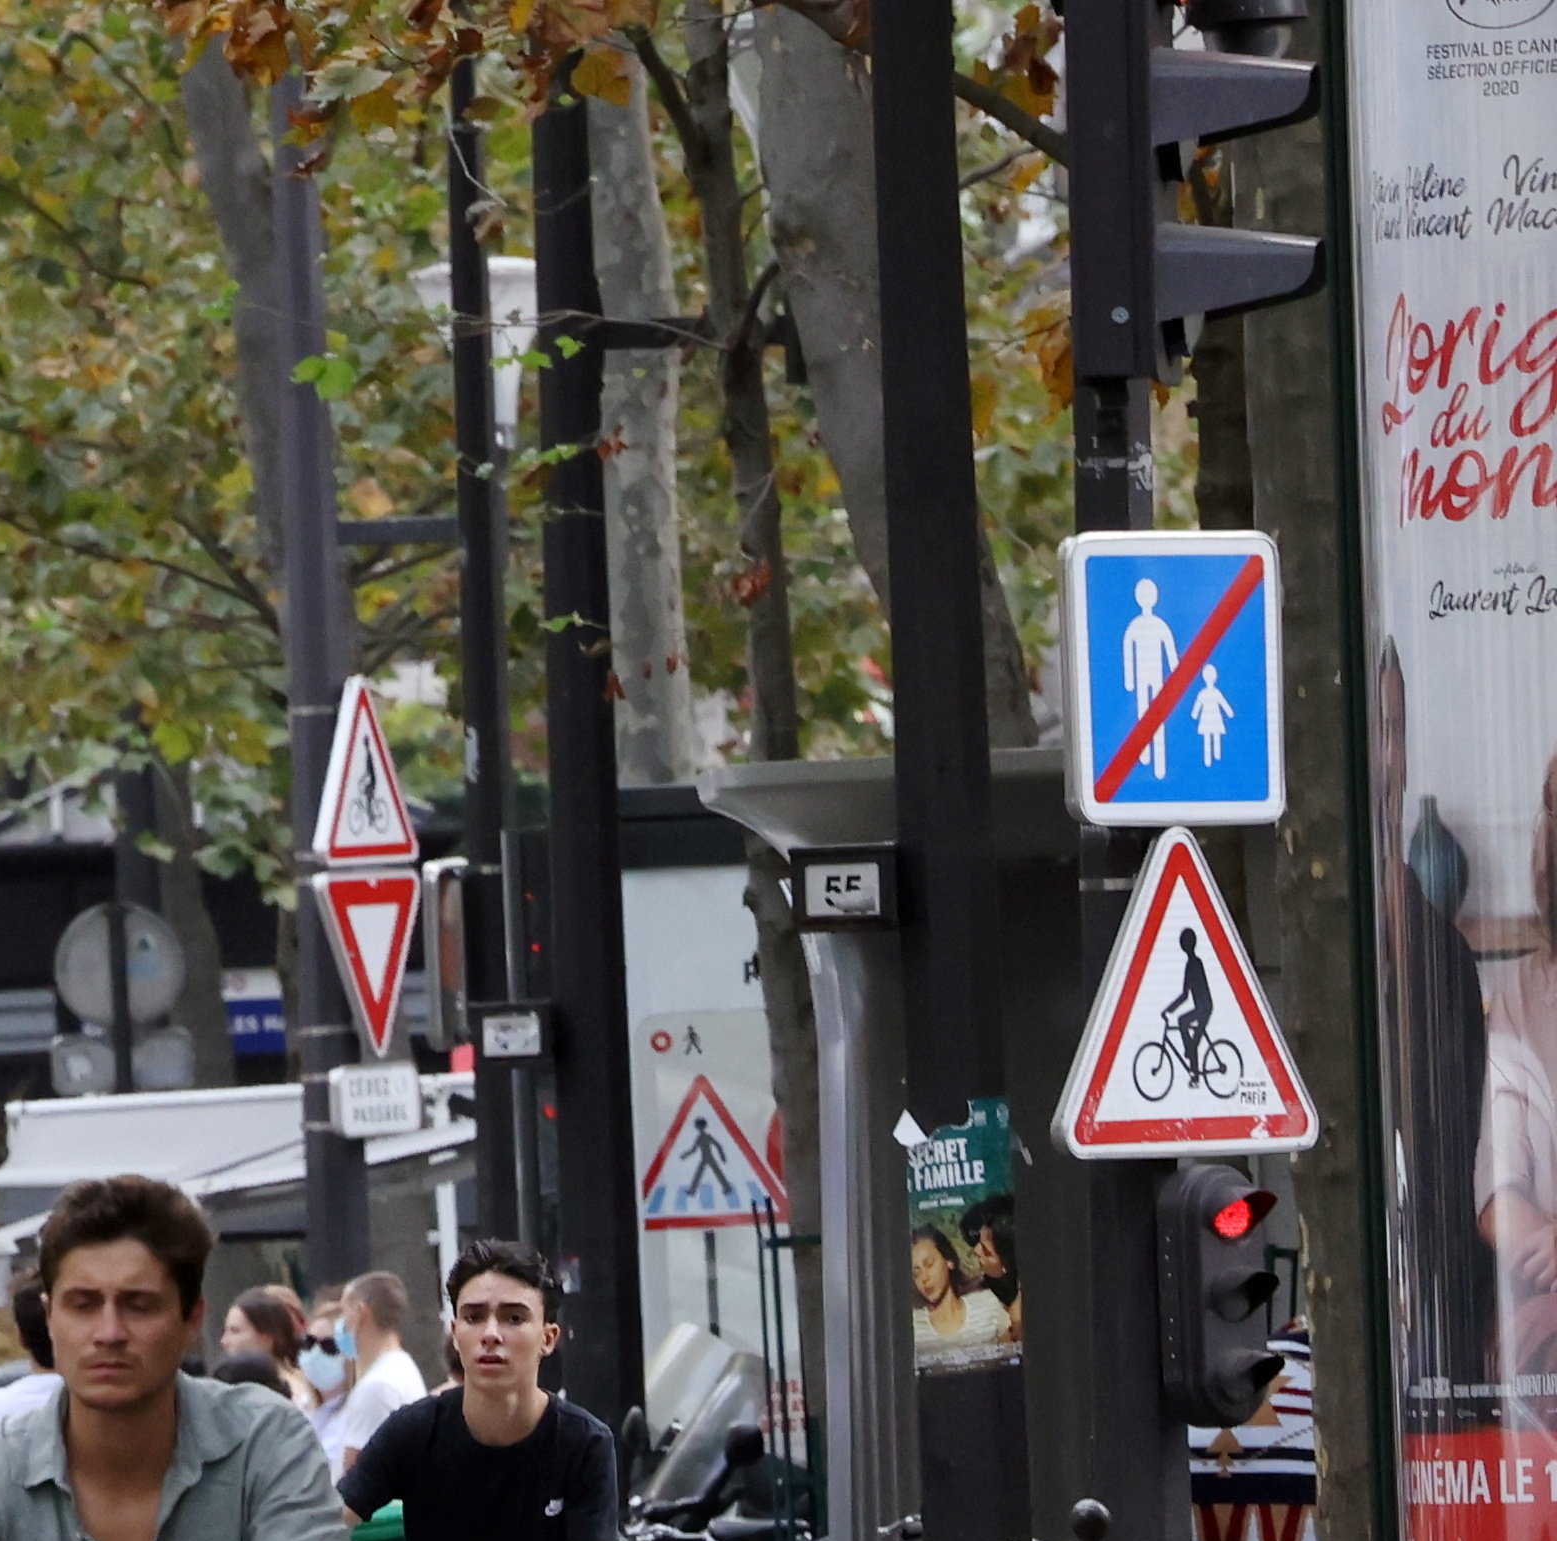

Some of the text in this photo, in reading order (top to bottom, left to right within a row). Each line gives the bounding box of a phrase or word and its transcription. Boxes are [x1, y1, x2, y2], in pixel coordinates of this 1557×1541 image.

[1426, 41, 1490, 60] FESTIVAL
[1492, 40, 1514, 56] DE
[1427, 62, 1497, 80] SÉLECTION
[1483, 80, 1520, 97] 2020
[1431, 382, 1491, 448] du
[1429, 580, 1520, 620] Laurent
[1499, 1458, 1535, 1504] LE
